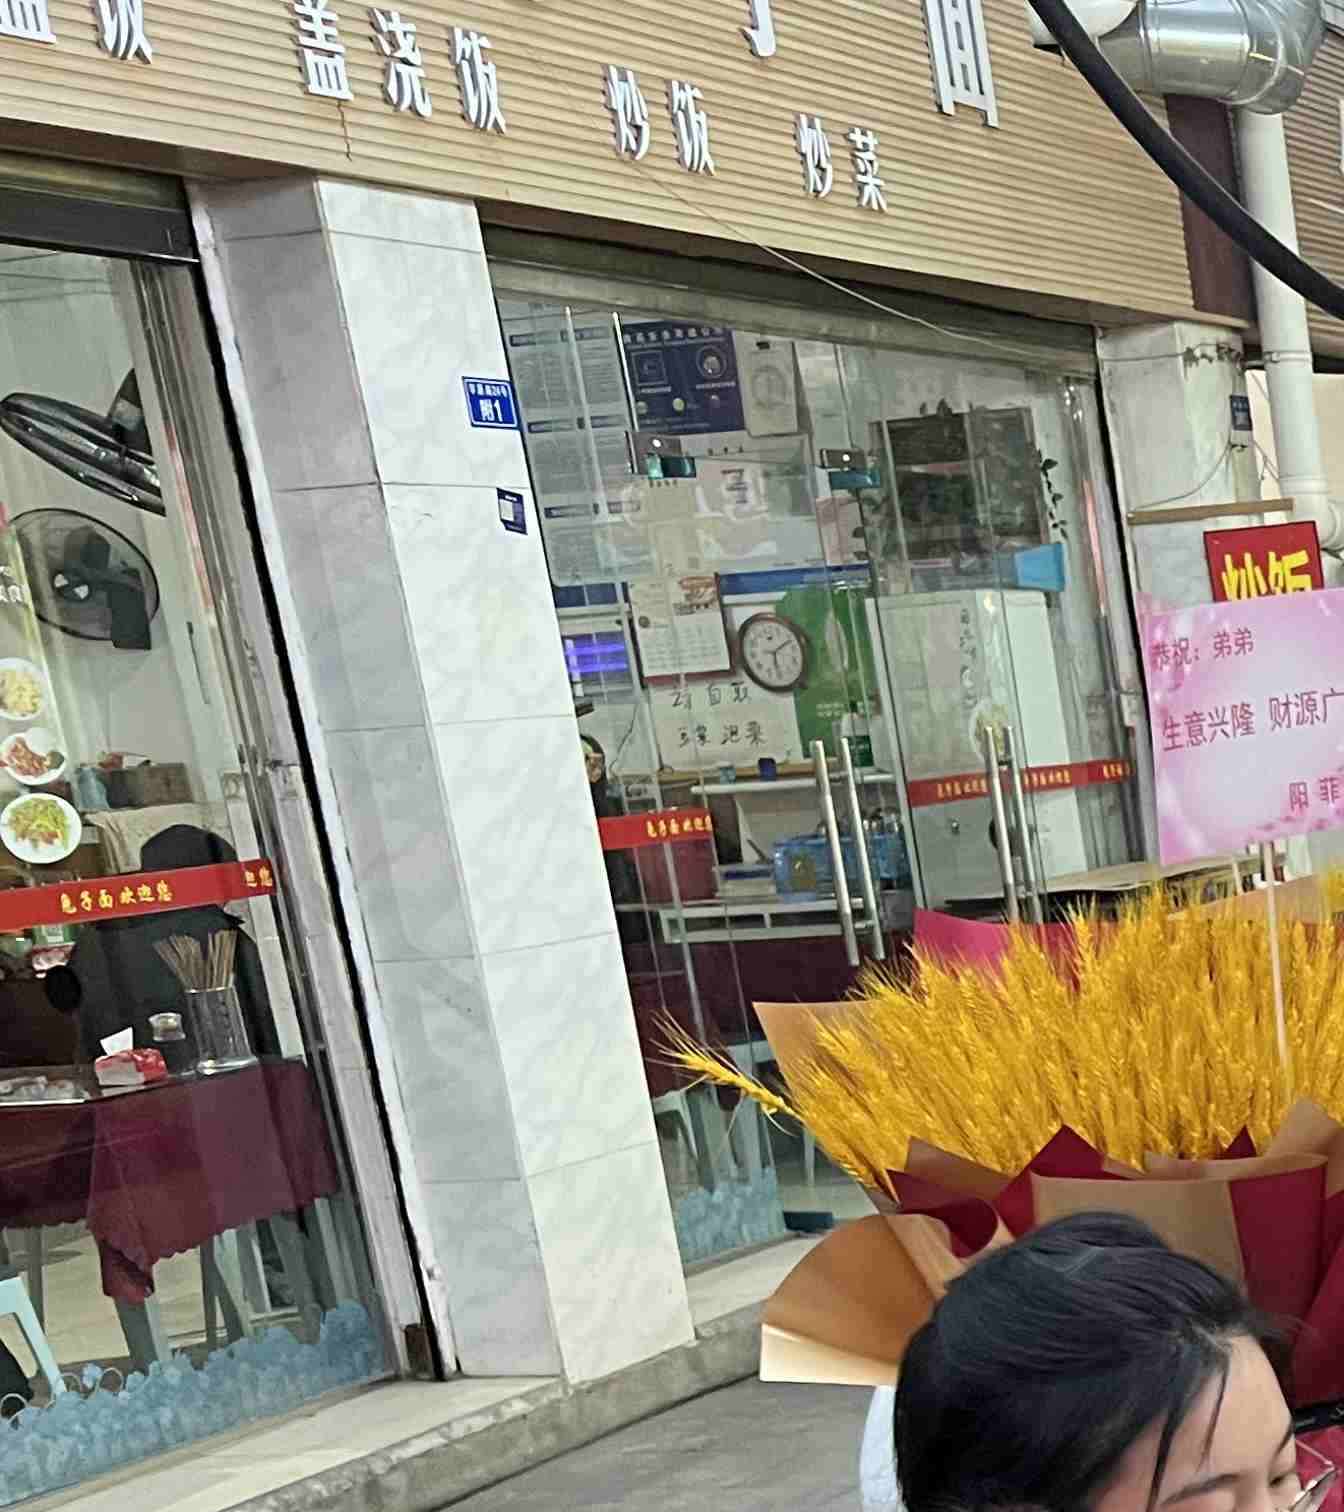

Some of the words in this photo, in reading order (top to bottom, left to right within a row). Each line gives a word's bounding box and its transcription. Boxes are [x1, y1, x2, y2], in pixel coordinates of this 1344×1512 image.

[293, 0, 505, 133] 盖浇饭
[606, 64, 717, 177] 炒饭
[798, 112, 888, 212] 炒菜
[1162, 701, 1256, 752] 生意兴隆
